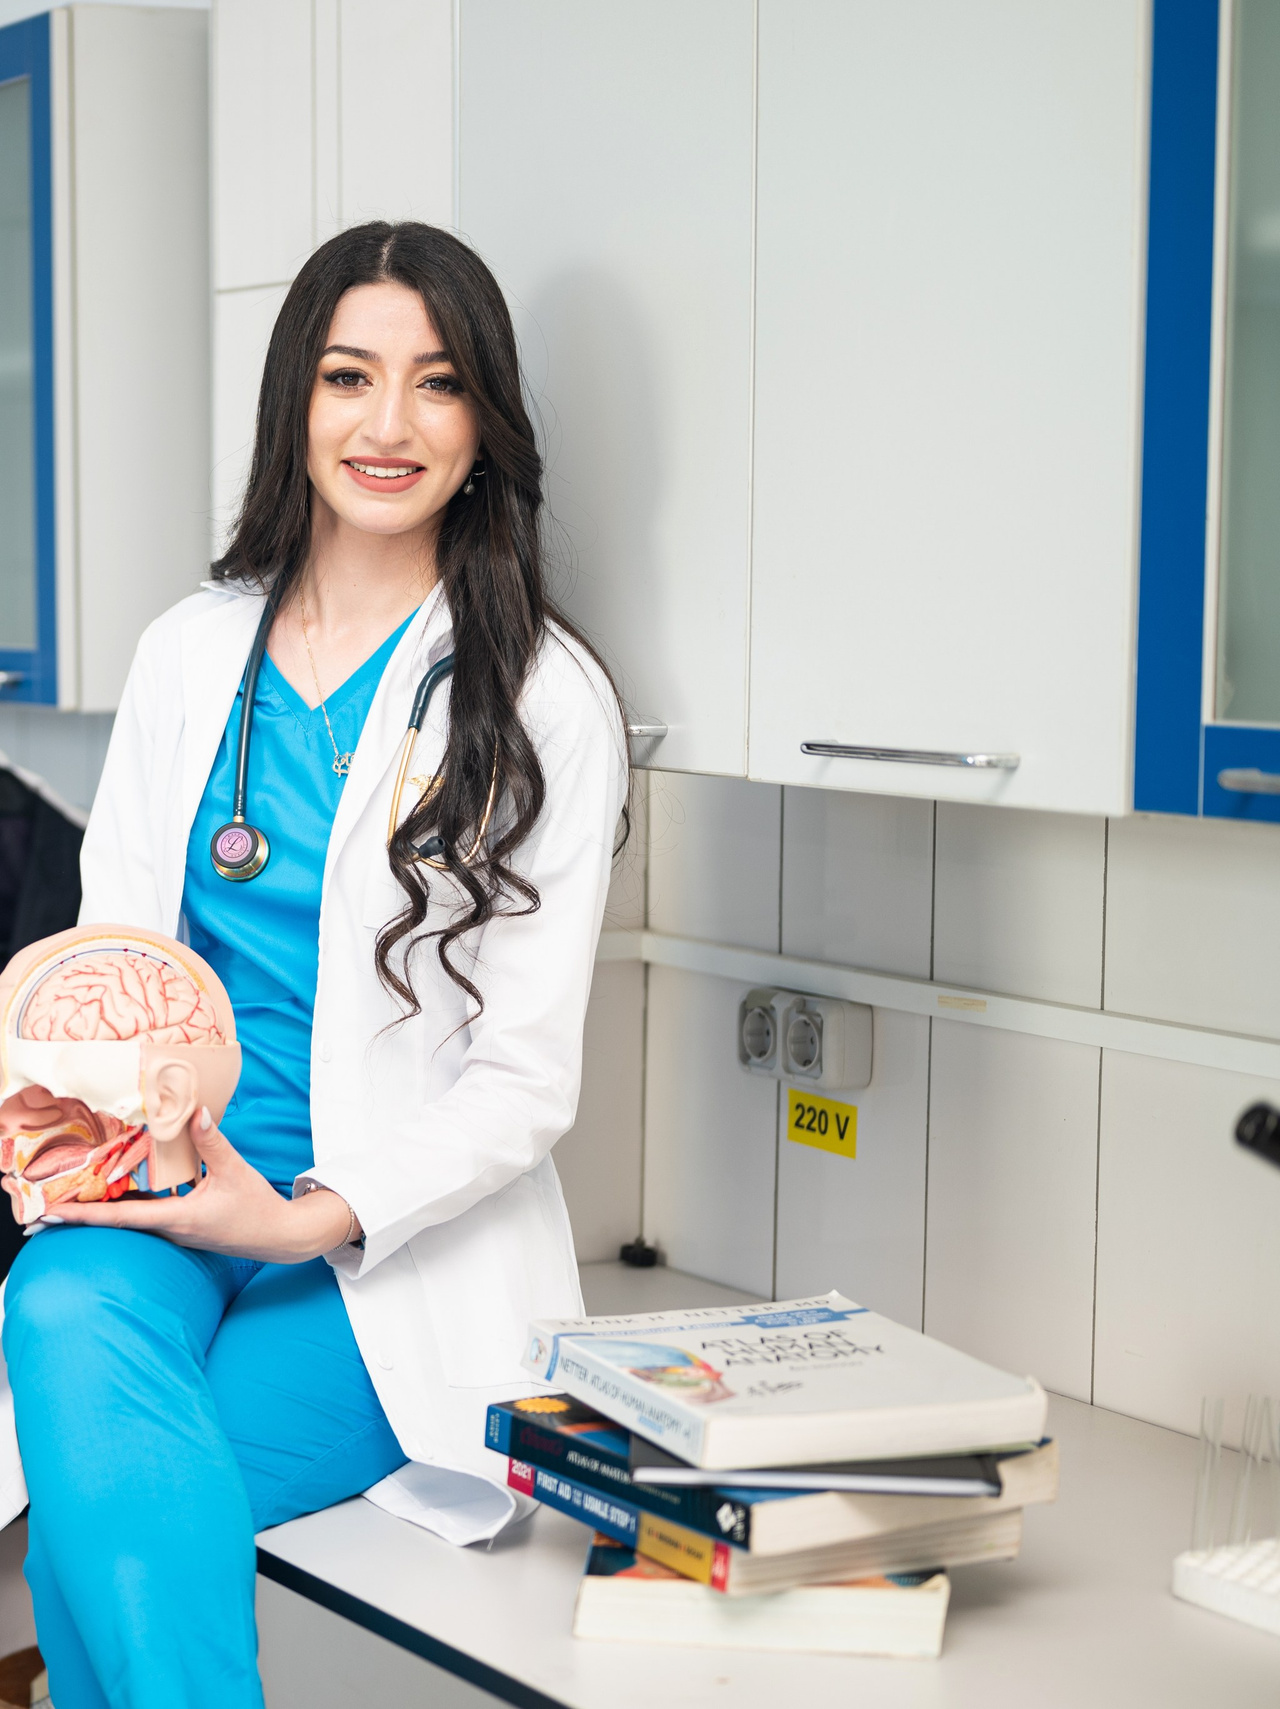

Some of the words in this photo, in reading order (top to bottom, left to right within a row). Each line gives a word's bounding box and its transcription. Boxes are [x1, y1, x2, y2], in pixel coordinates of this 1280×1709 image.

[794, 1103, 829, 1135] 220
[835, 1112, 850, 1141] V
[559, 1318, 638, 1327] FRANK
[701, 1333, 797, 1350] ATLAS
[802, 1329, 847, 1341] OF
[722, 1338, 856, 1356] HUMAN
[726, 1346, 884, 1367] ANATOMY
[559, 1356, 588, 1383] NETTER
[591, 1374, 610, 1396] ATLAS
[648, 1407, 683, 1433] ANATOMY
[511, 1459, 532, 1481] 2021
[600, 1463, 631, 1484] ANATOM
[536, 1470, 559, 1495] FIRST
[557, 1480, 572, 1501] AID
[583, 1493, 610, 1520] USMLE
[609, 1505, 631, 1529] STEP
